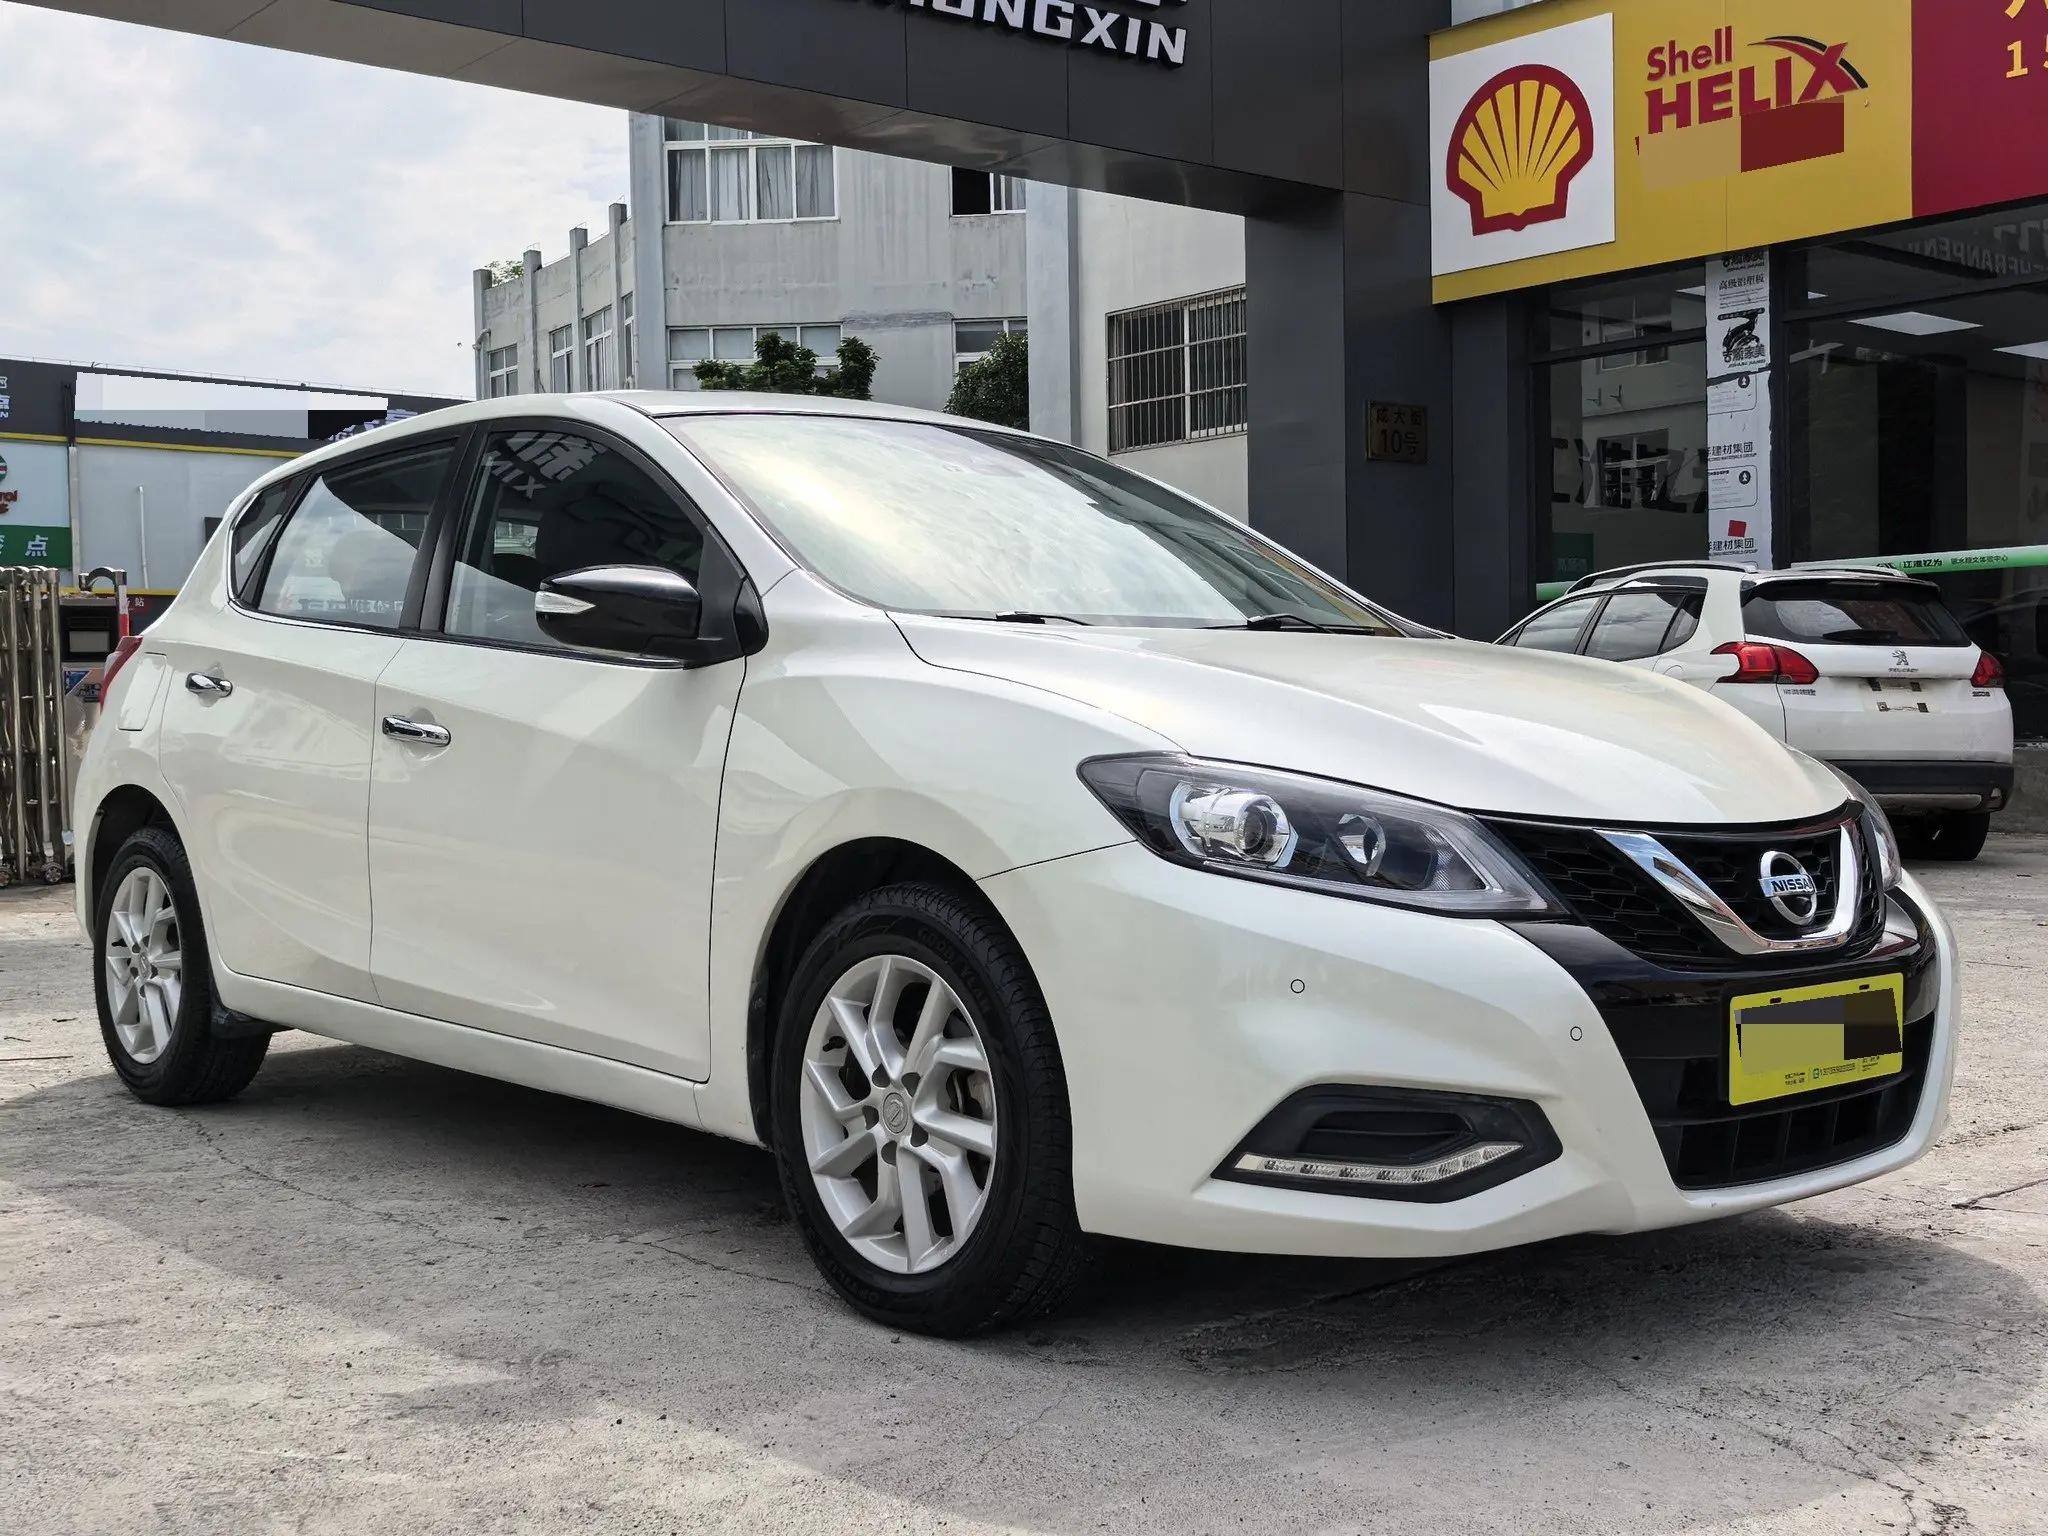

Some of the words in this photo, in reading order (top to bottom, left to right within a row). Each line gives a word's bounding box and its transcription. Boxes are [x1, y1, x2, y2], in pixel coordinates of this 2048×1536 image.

[910, 0, 1187, 64] NGXIN
[1647, 26, 1733, 82] Shell
[1645, 42, 1859, 134] HELIX
[1380, 429, 1419, 455] 10号
